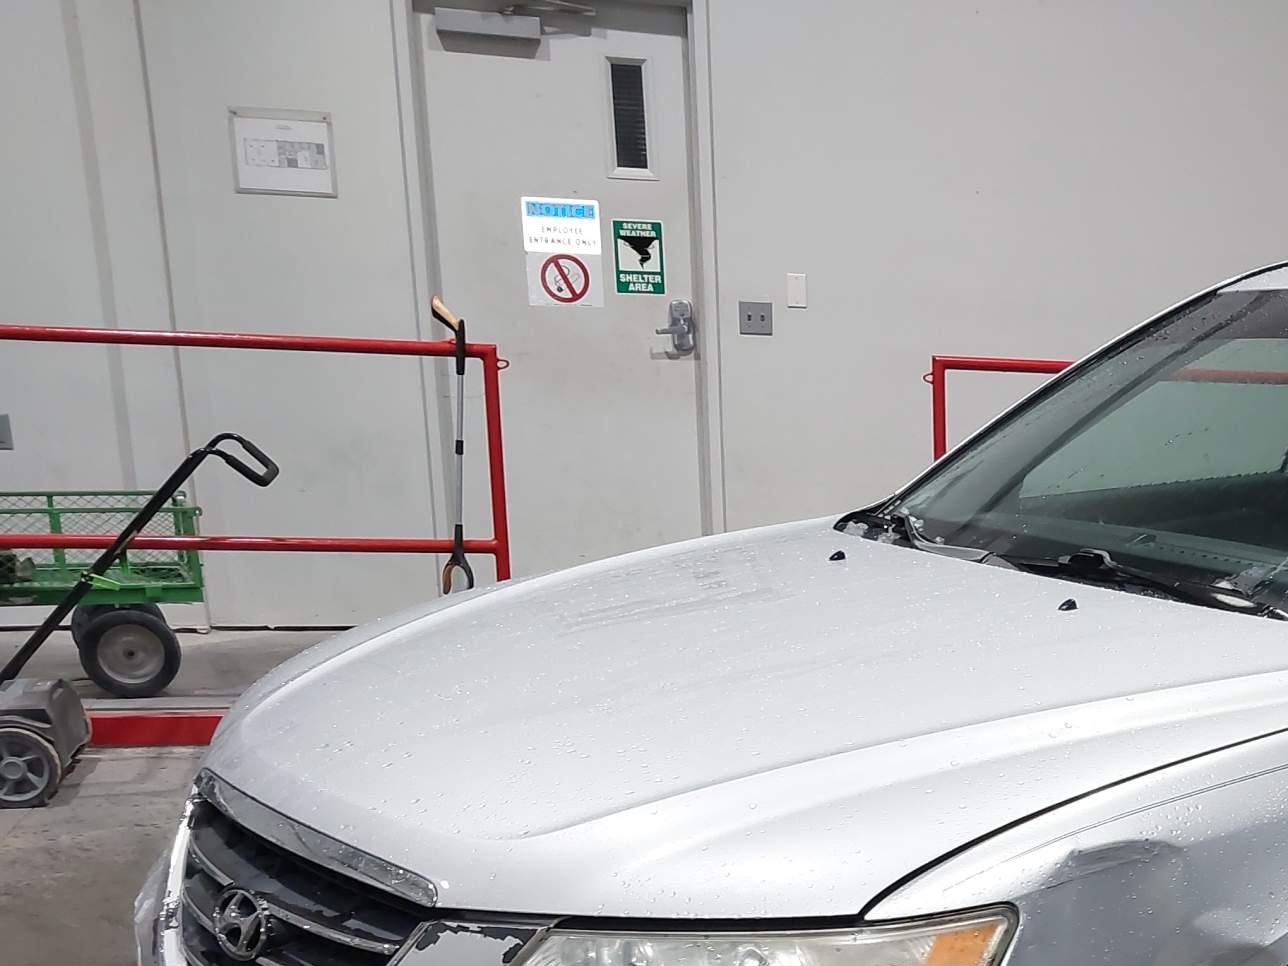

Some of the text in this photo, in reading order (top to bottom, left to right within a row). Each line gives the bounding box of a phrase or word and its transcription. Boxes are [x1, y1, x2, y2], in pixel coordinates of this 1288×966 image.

[527, 202, 595, 218] NOTICE
[541, 226, 583, 235] EMPLOYEE
[622, 222, 653, 231] SEVERE
[619, 229, 657, 238] WEATHER
[529, 237, 597, 247] ENTRANCE ONLY
[619, 273, 662, 284] SHELTER
[628, 282, 654, 293] AREA
